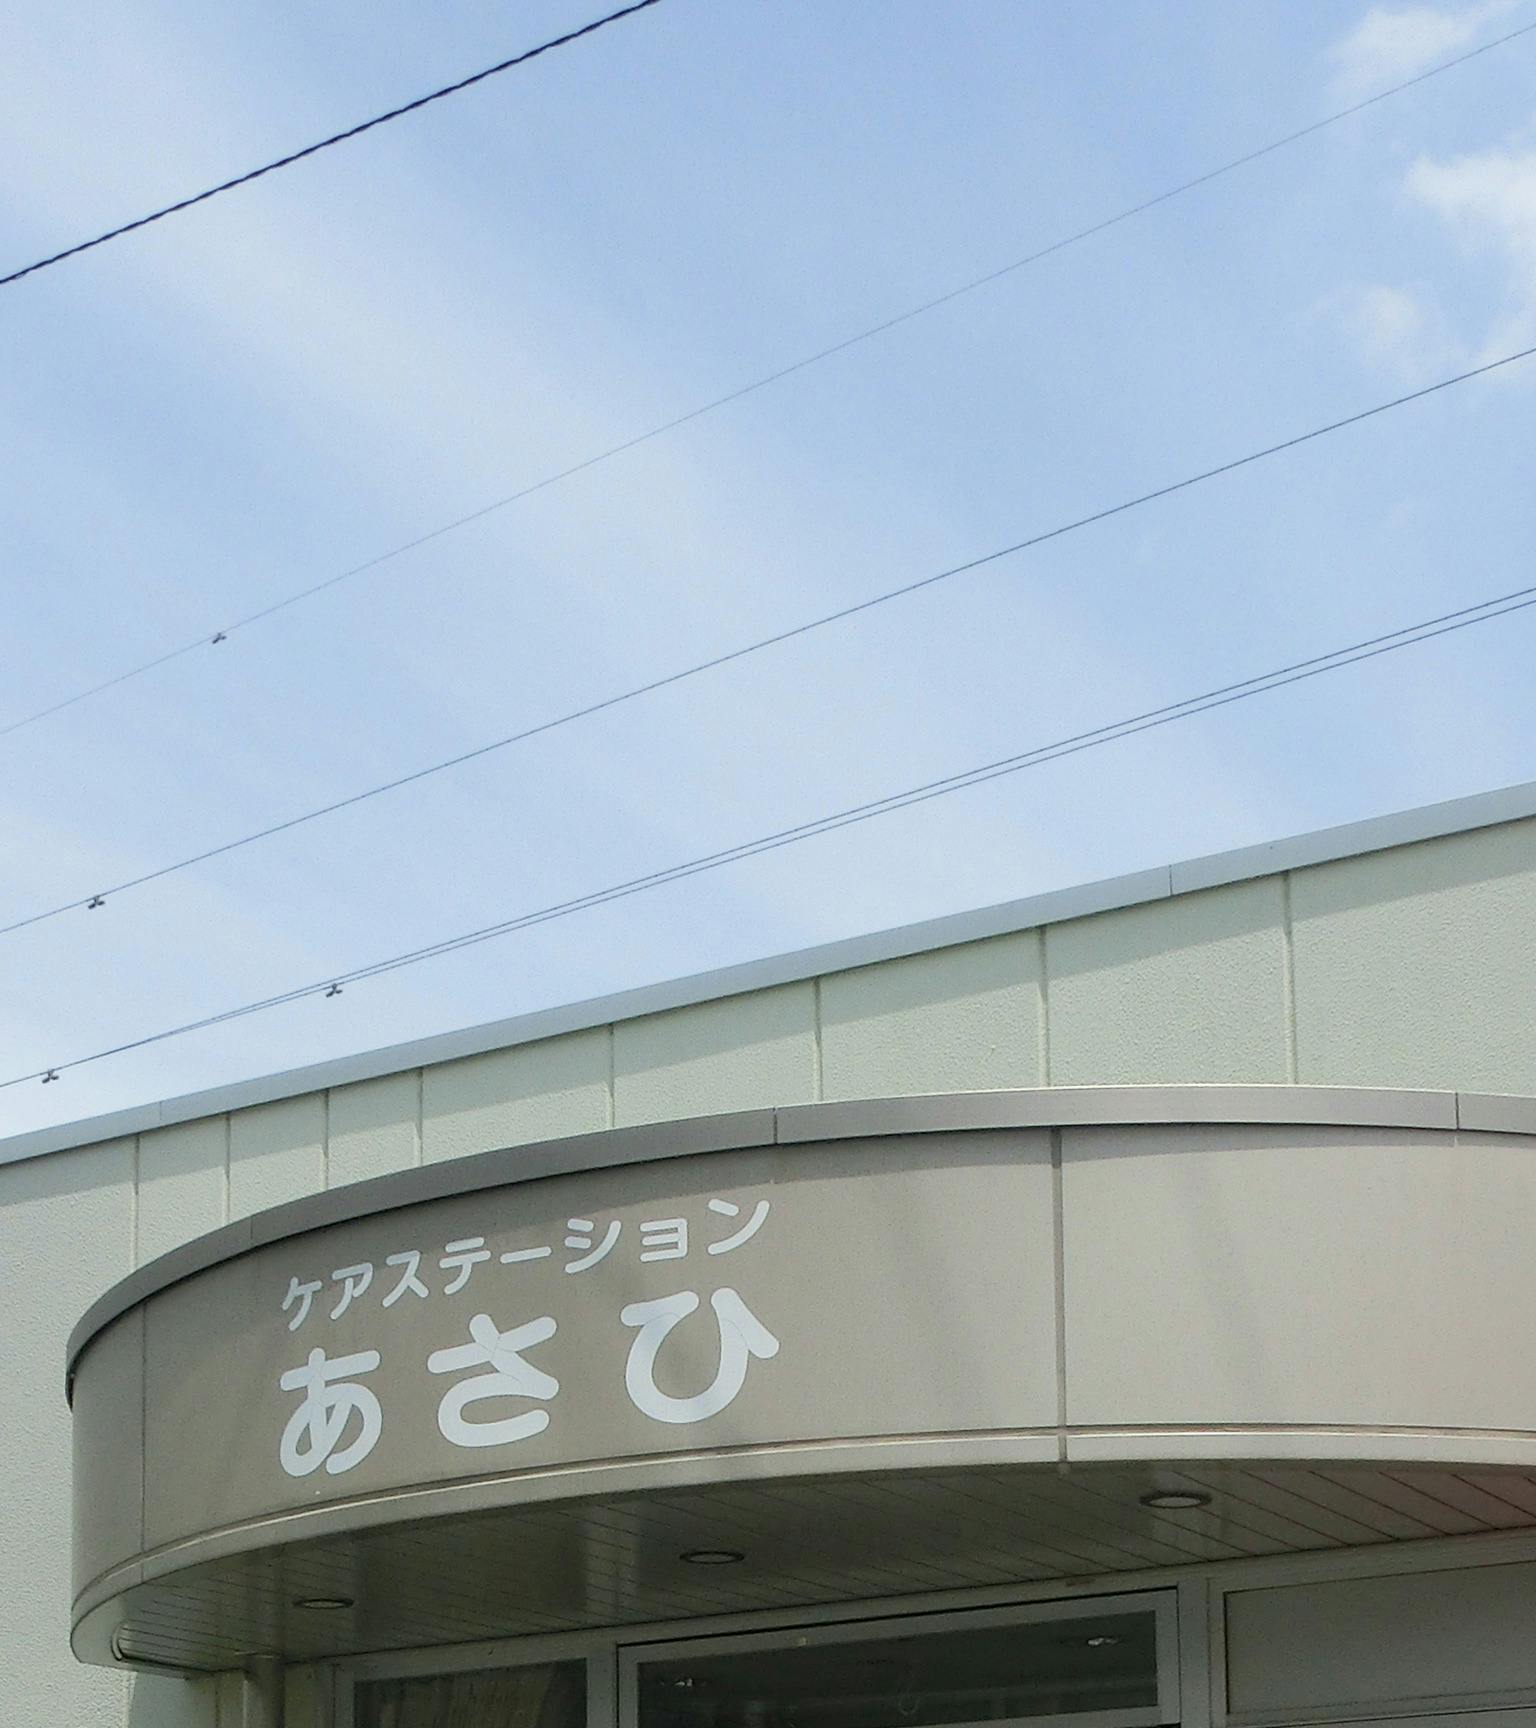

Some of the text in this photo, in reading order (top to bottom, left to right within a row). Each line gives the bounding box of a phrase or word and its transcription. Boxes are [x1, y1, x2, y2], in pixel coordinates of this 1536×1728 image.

[283, 1200, 770, 1331] ケアステーション
[280, 1287, 780, 1477] あさひ
